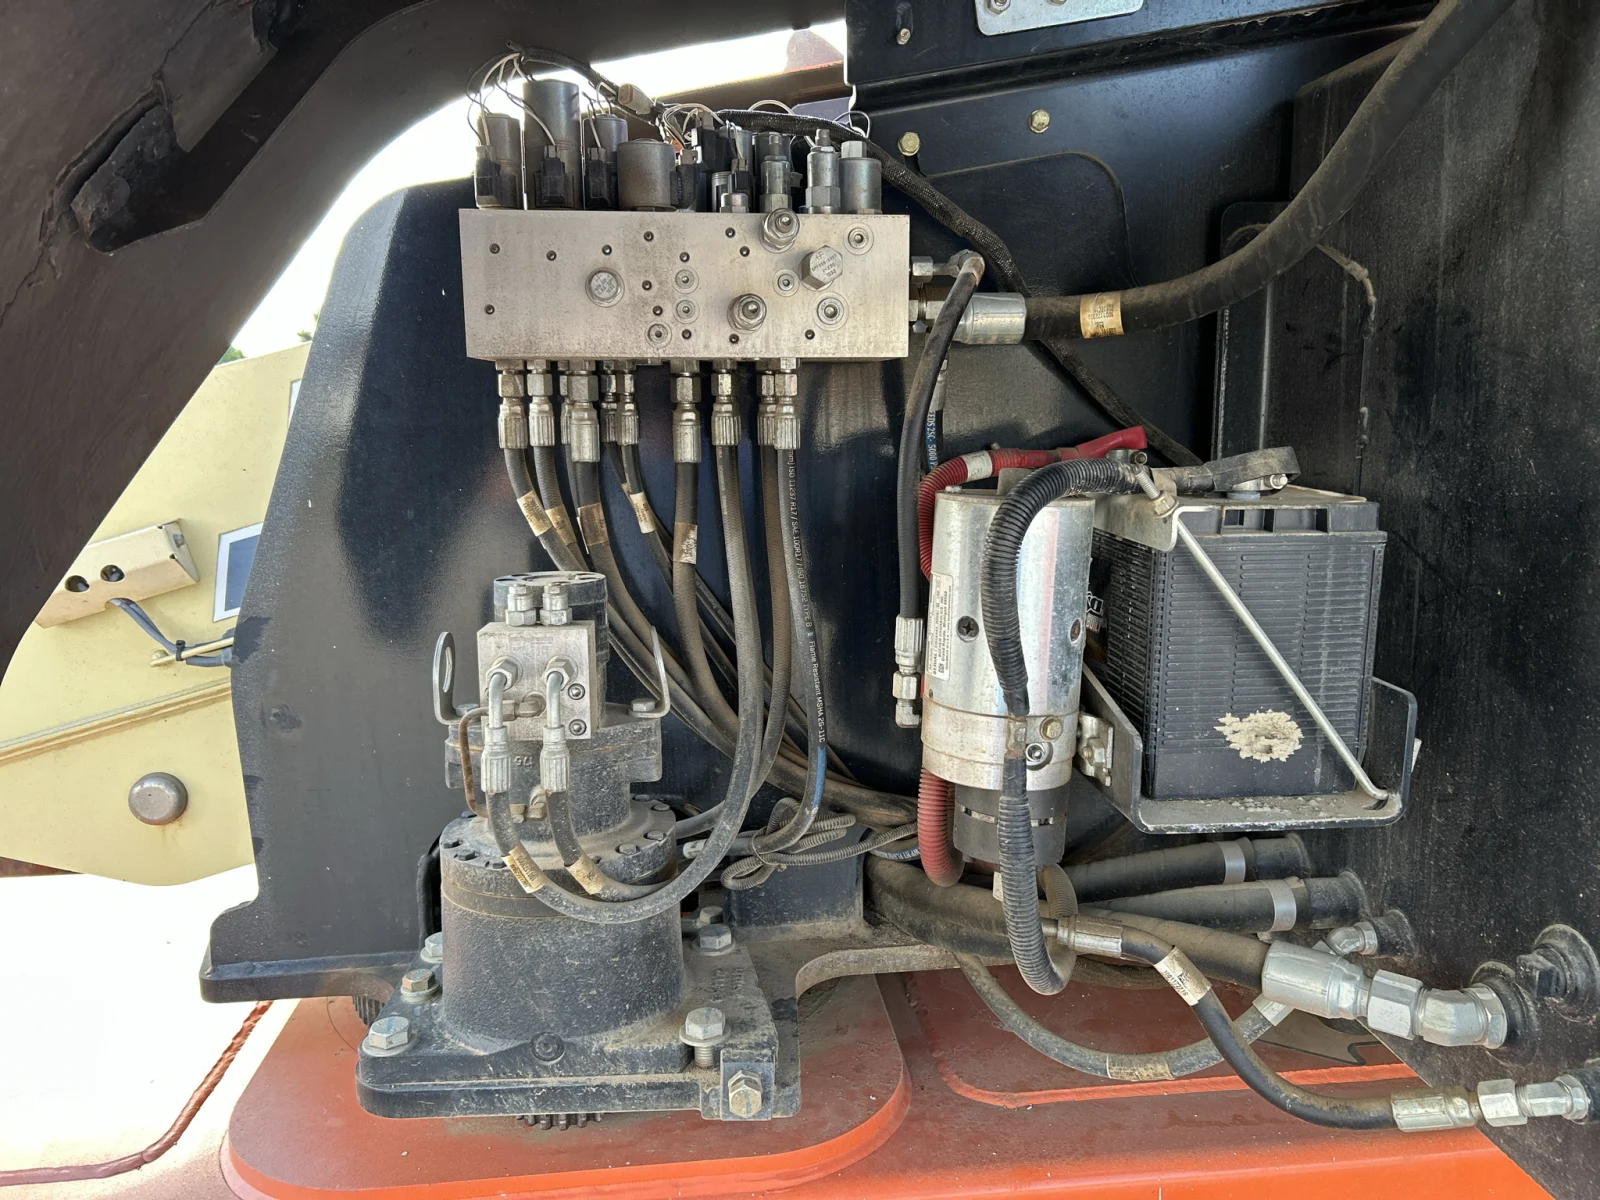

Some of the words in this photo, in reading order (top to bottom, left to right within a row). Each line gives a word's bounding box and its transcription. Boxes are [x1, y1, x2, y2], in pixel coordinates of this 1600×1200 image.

[927, 444, 937, 460] 5000
[793, 535, 802, 561] 100R17
[798, 580, 808, 602] 18752
[802, 604, 811, 620] TYPE
[809, 640, 817, 663] Flame
[812, 663, 822, 696] Resistant
[816, 696, 824, 717] MSHA
